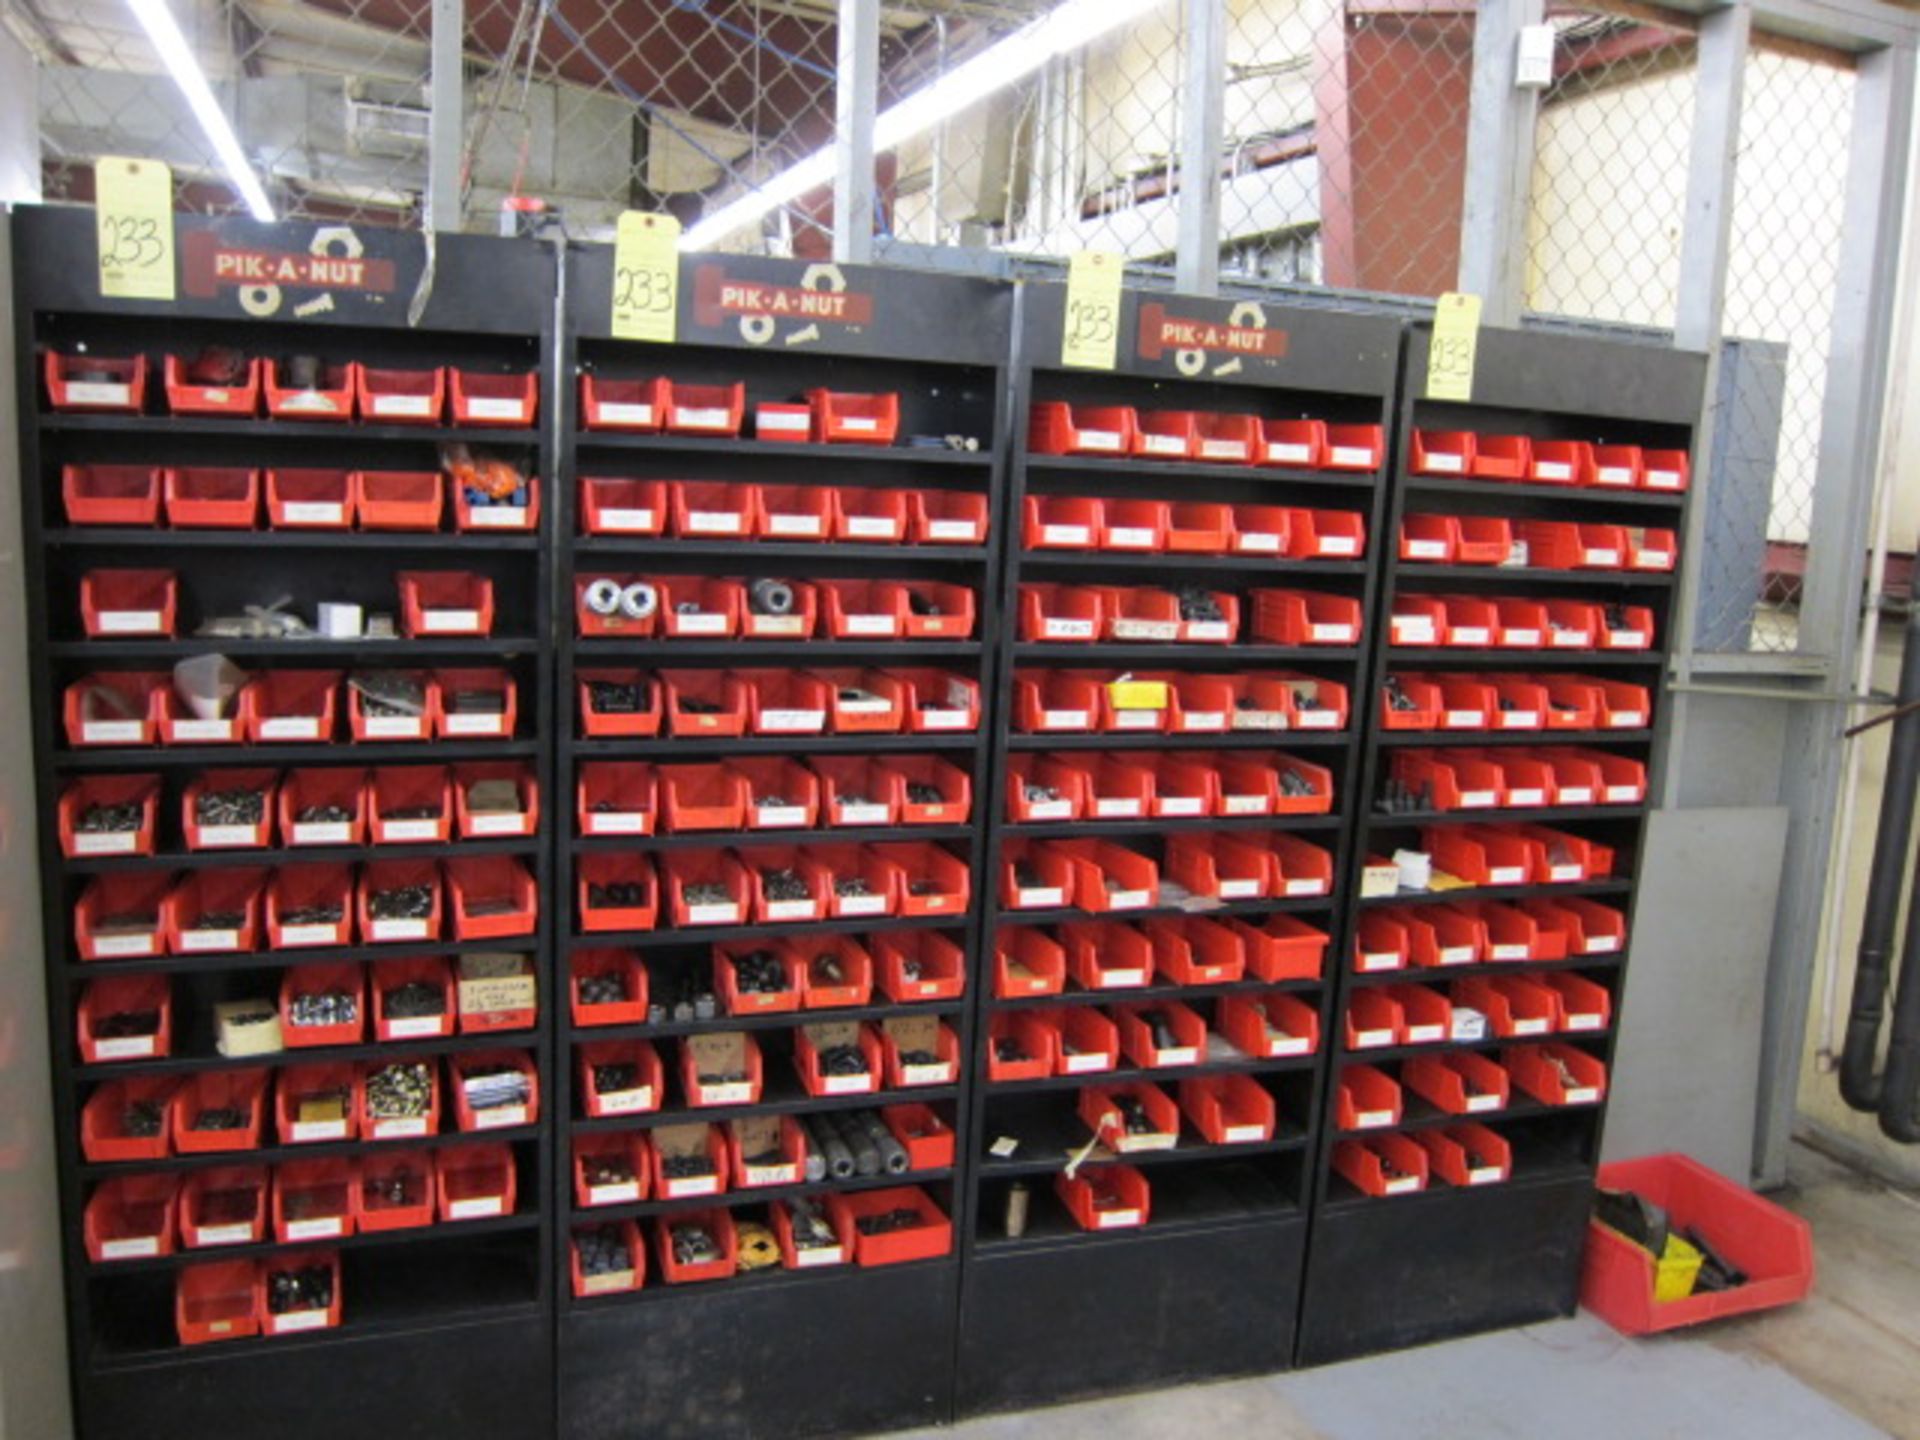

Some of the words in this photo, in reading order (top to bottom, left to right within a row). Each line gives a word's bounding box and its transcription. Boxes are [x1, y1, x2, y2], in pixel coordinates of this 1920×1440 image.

[101, 214, 166, 269] 233
[614, 266, 673, 313] 233
[1067, 299, 1114, 350] 233
